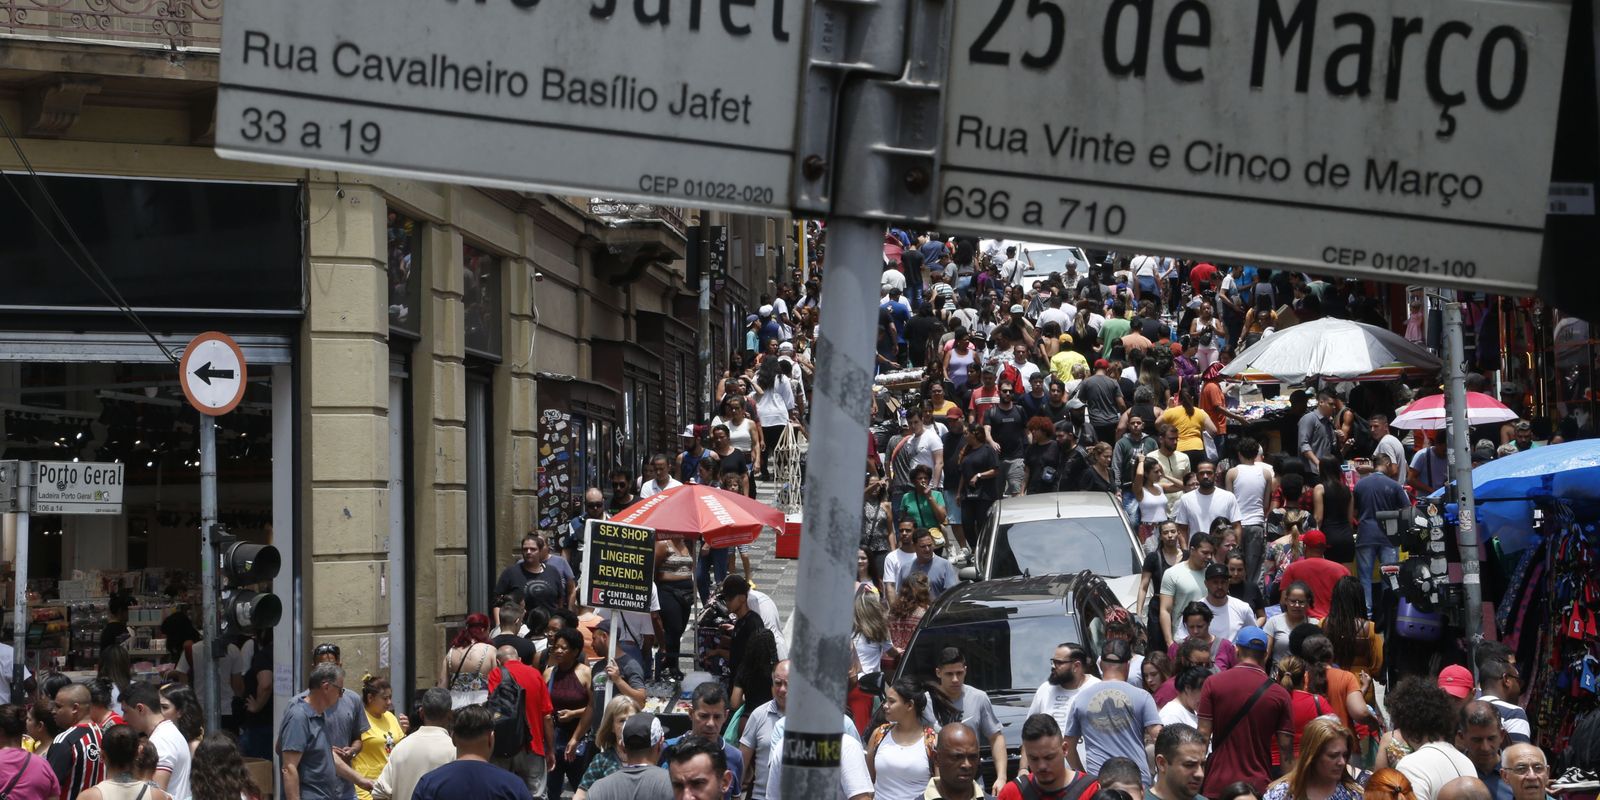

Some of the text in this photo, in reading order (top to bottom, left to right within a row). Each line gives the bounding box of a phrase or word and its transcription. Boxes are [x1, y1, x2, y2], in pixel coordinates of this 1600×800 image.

[243, 30, 753, 126] Rua Cavalheiro Basílio Jafet
[969, 0, 1529, 137] 25 de Março
[240, 107, 381, 155] 33 a 19
[956, 115, 1028, 154] Rua
[1043, 123, 1136, 166] Vinte
[1149, 143, 1171, 170] e
[1183, 139, 1292, 182] Cinco
[1304, 154, 1351, 187] de
[1364, 158, 1484, 208] Março
[639, 174, 774, 206] CEP 01022-020
[943, 185, 1127, 236] 636 a 710
[1321, 245, 1478, 279] CEP 01021-100
[39, 464, 122, 486] Porto Geral
[77, 492, 91, 500] Geral
[600, 525, 648, 541] SEX SHOP
[601, 549, 644, 565] LINGERIE
[599, 565, 643, 580] REVENDA
[606, 590, 634, 601] CENTRAL
[635, 594, 648, 602] DAS
[609, 598, 644, 608] CALCINHAS
